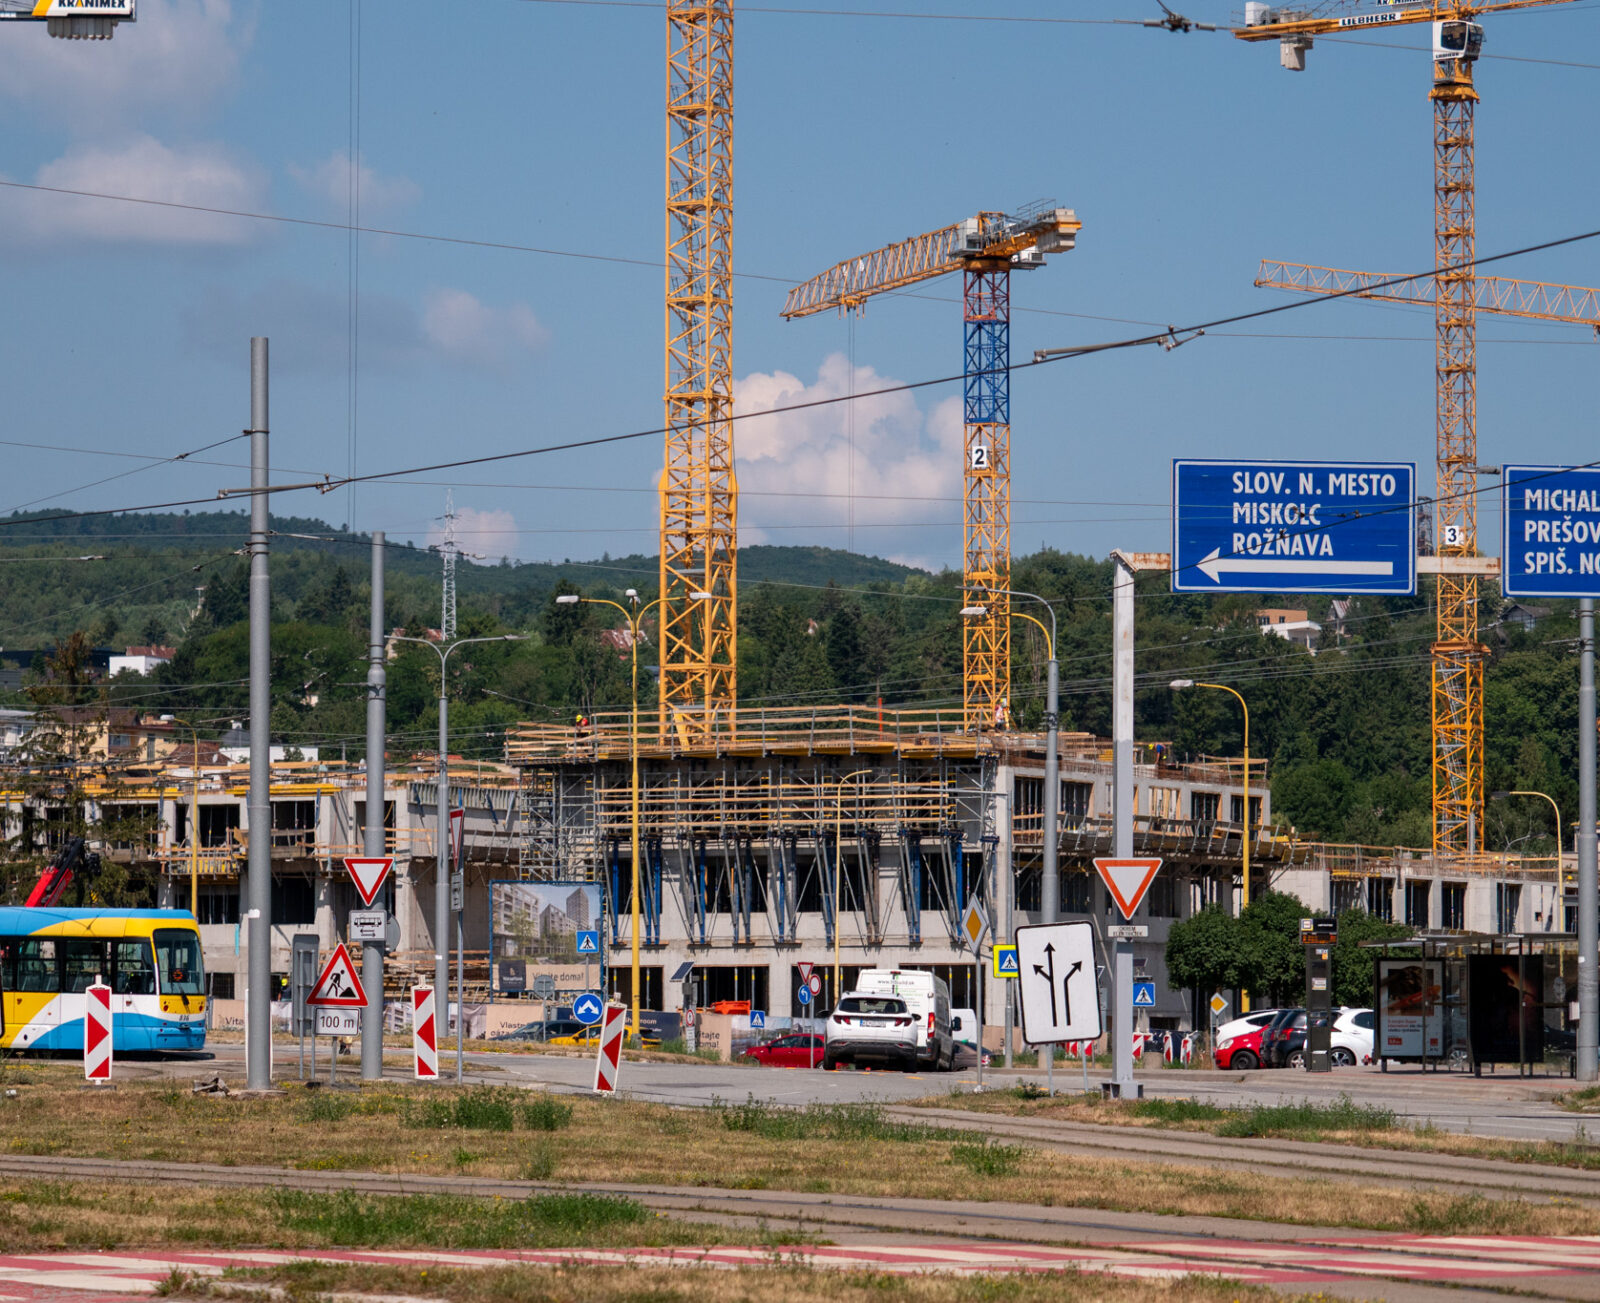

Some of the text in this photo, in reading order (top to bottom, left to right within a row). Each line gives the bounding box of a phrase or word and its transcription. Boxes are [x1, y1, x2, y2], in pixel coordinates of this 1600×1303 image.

[1341, 13, 1396, 26] LIEBHERR
[975, 448, 985, 465] 2
[1232, 471, 1396, 496] SLOV. N. MESTO
[1233, 502, 1322, 526] MISKOLC
[1448, 528, 1457, 543] 3
[1524, 515, 1600, 543] PREŠOV
[1232, 528, 1334, 556] ROŽŇAVA
[1524, 547, 1573, 574] SPIŠ.
[560, 972, 584, 981] doma!
[320, 1016, 354, 1028] 100 m
